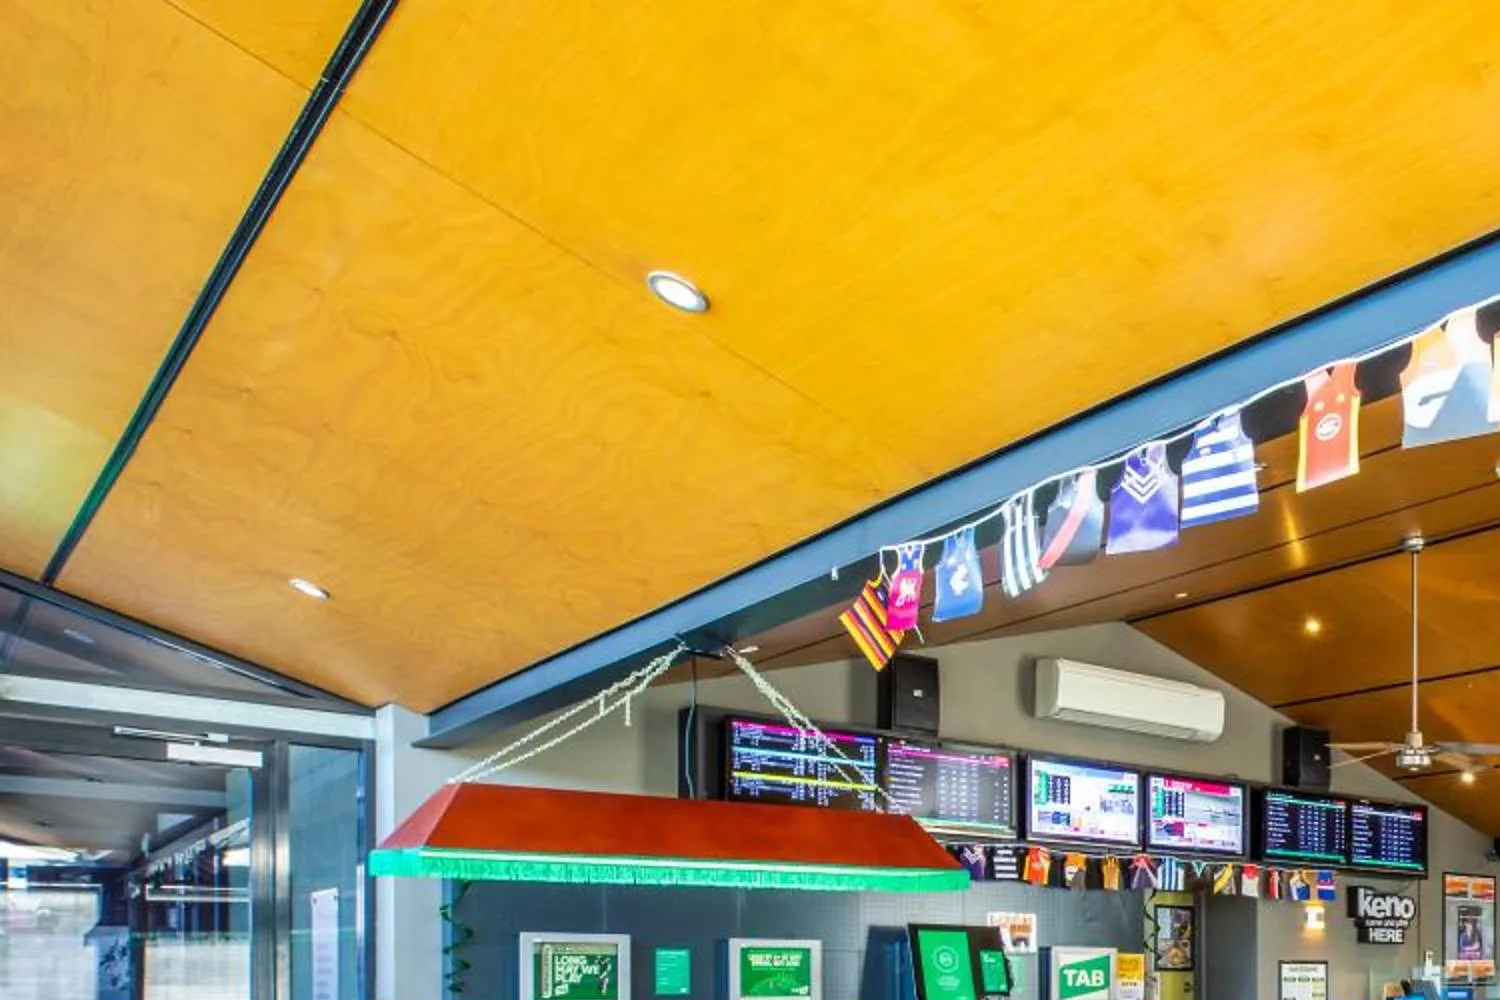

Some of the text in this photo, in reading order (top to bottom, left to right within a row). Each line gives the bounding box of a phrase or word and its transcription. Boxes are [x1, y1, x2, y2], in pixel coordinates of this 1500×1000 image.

[1358, 888, 1414, 918] keno
[1369, 928, 1403, 942] HERE
[555, 955, 587, 965] LONG
[555, 964, 600, 975] MAY WE
[555, 973, 582, 984] PLAY
[1063, 969, 1105, 987] TAB
